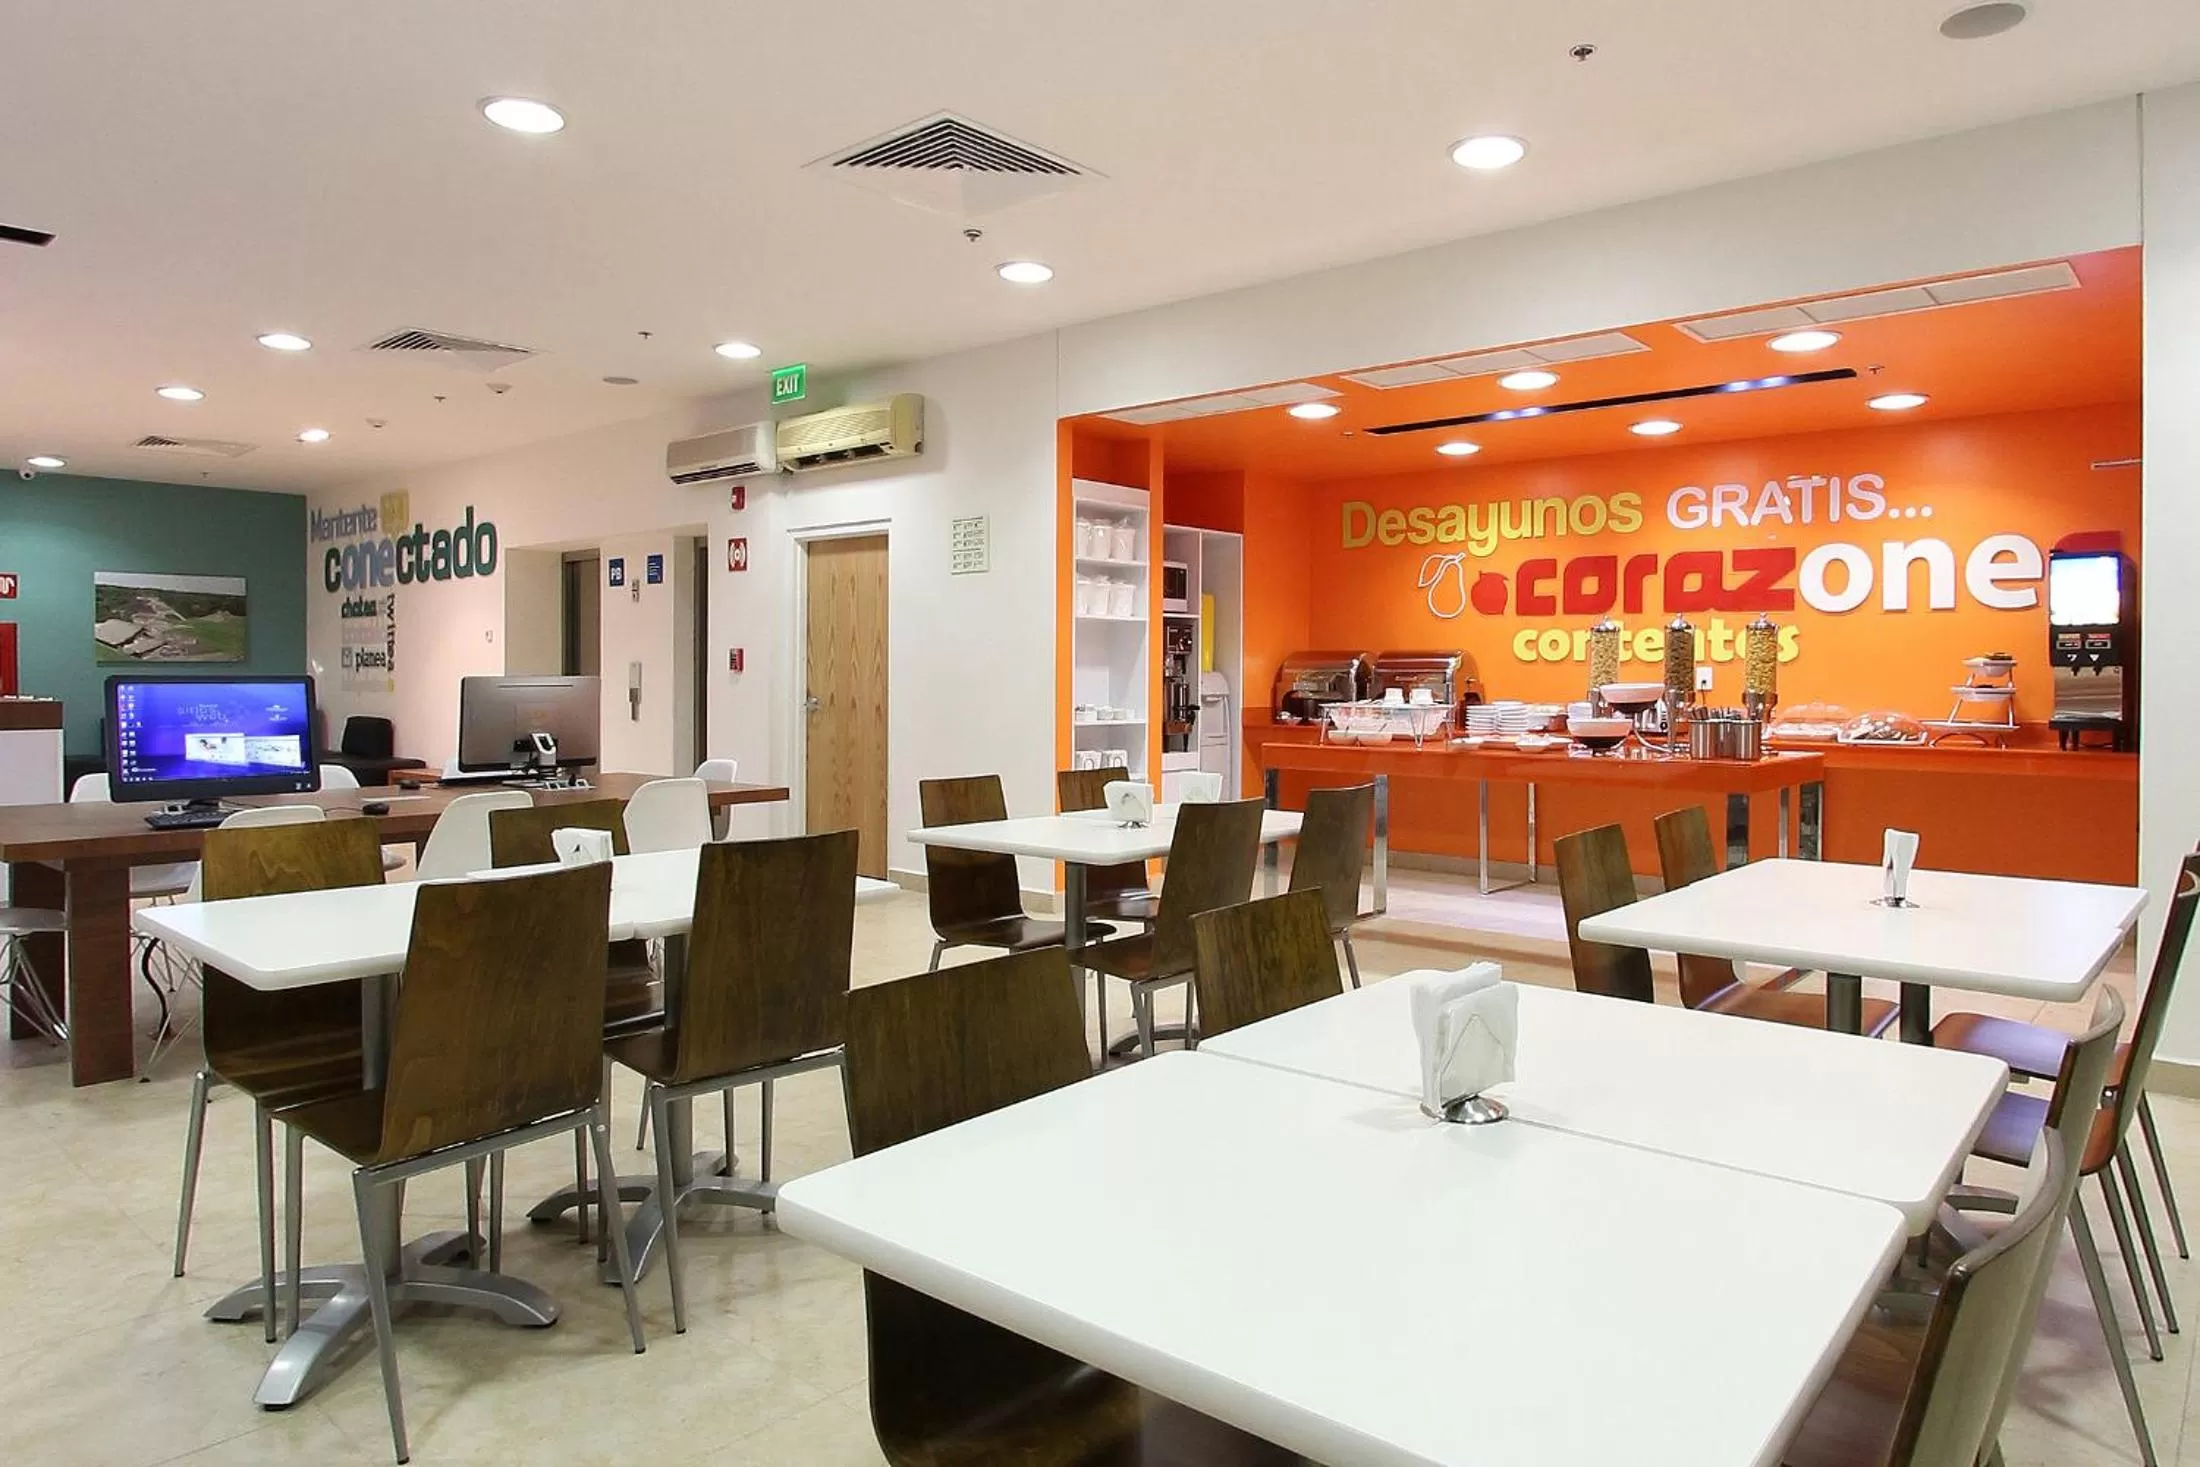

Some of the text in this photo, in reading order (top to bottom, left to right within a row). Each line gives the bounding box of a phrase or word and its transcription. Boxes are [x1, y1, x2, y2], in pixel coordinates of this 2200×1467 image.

[776, 374, 799, 397] EXIT
[310, 504, 377, 543] Mantente
[1342, 473, 1932, 557] Desayunos GRATIS...
[325, 506, 497, 593] conectado
[611, 567, 622, 580] PB
[1516, 530, 2122, 617] corazone
[356, 646, 387, 673] planea
[1513, 618, 1799, 664] cotets
